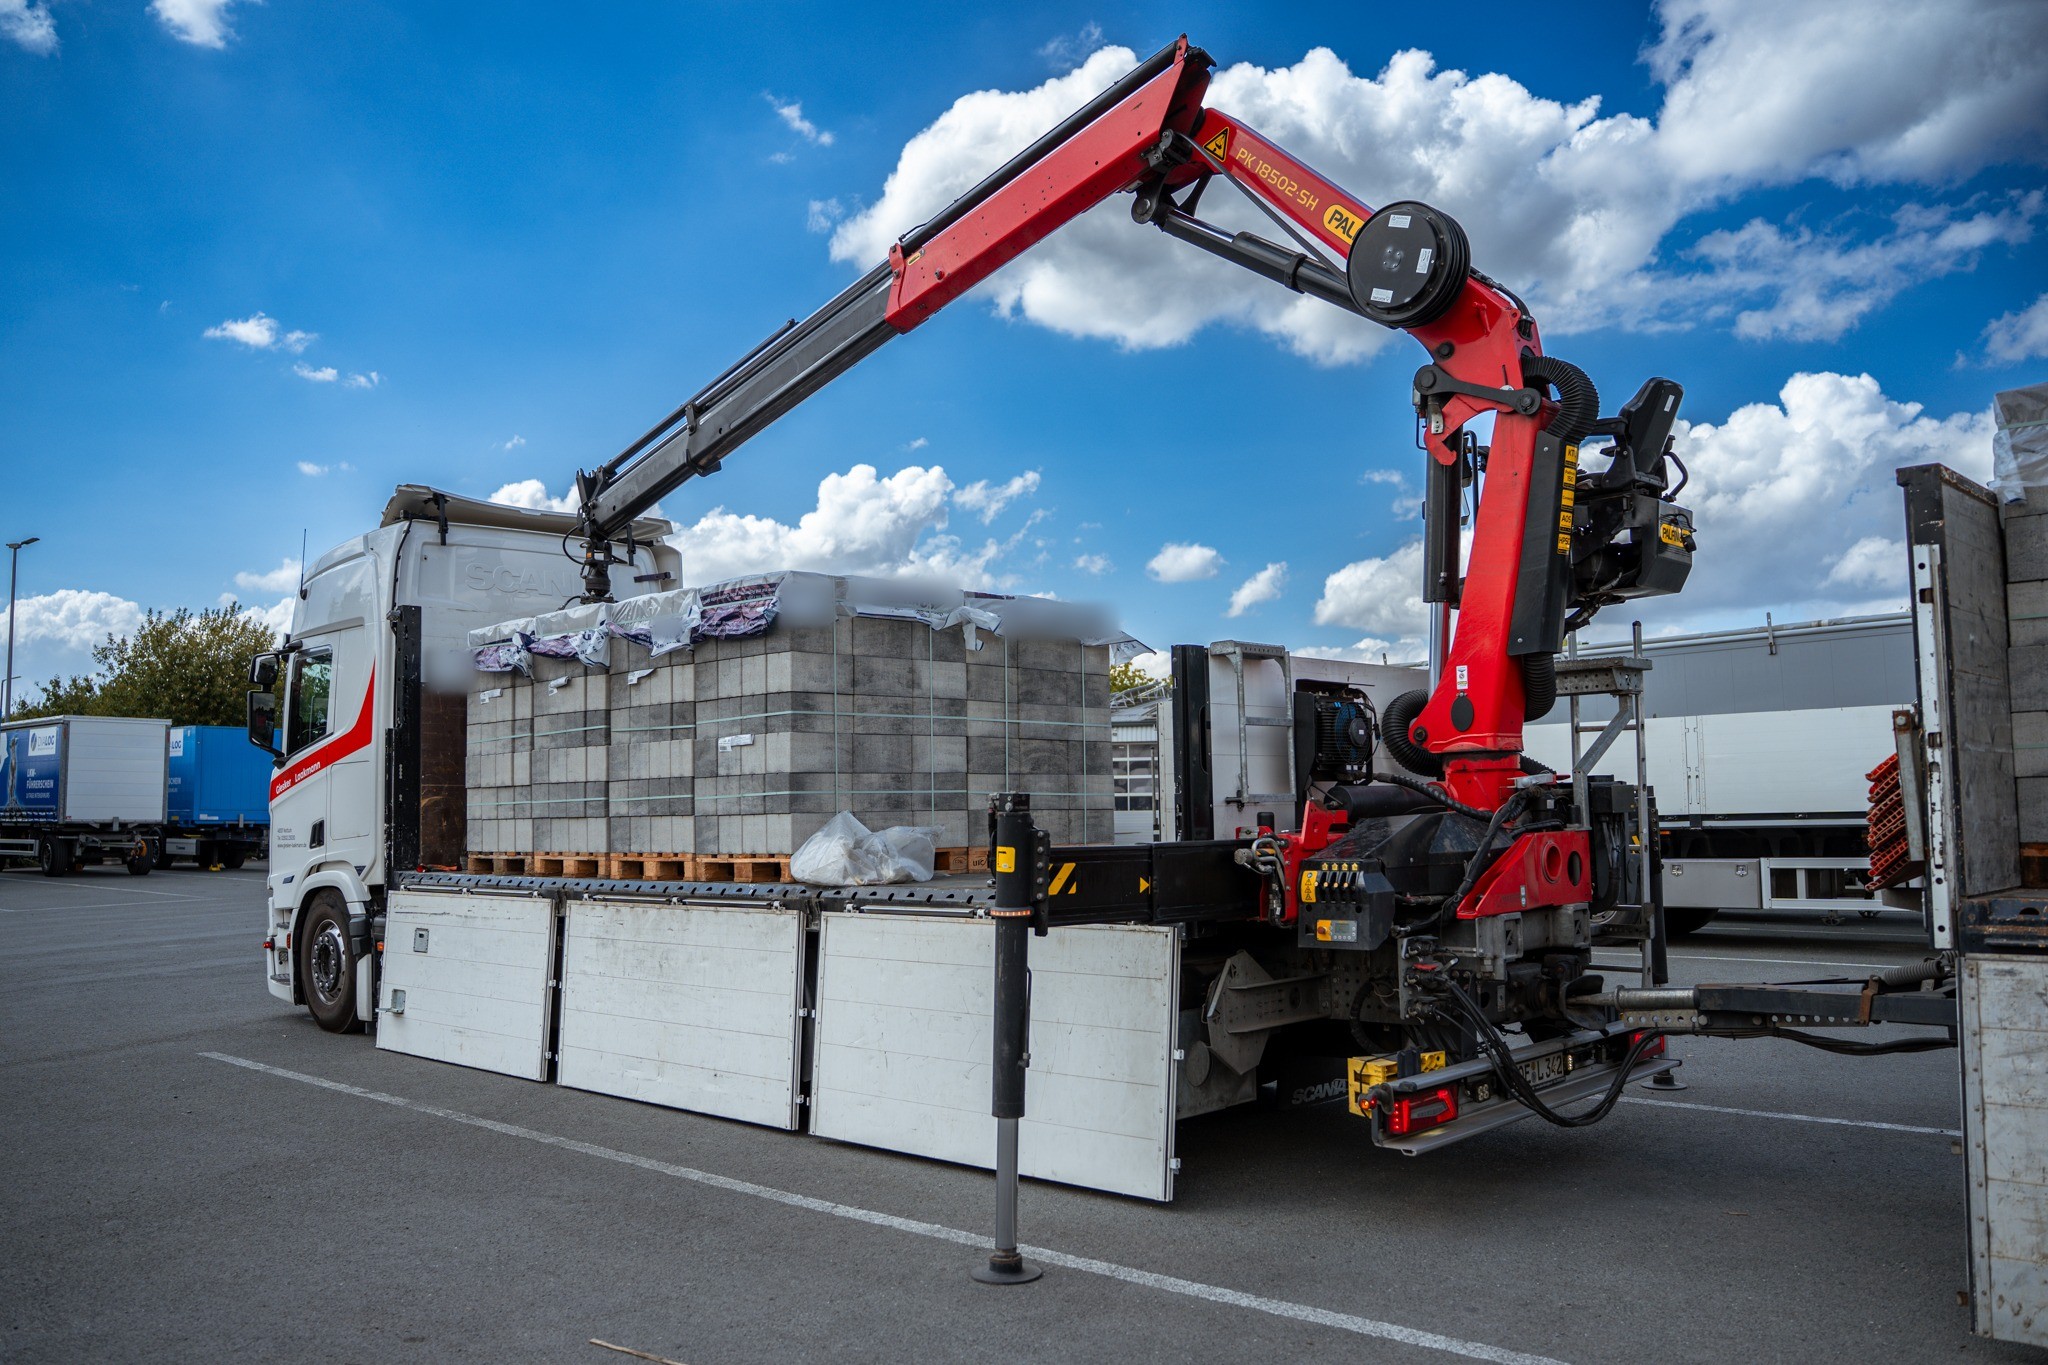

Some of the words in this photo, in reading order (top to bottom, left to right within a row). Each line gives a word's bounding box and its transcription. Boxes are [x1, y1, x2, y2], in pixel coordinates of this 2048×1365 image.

[1236, 147, 1257, 169] PK
[1327, 208, 1357, 241] PAL
[1662, 527, 1685, 543] PALFIN
[276, 780, 291, 794] Giesker
[295, 762, 320, 782] Laakmann
[1536, 1060, 1544, 1081] L
[1545, 1055, 1563, 1078] 342
[1291, 1079, 1347, 1105] SCANIA
